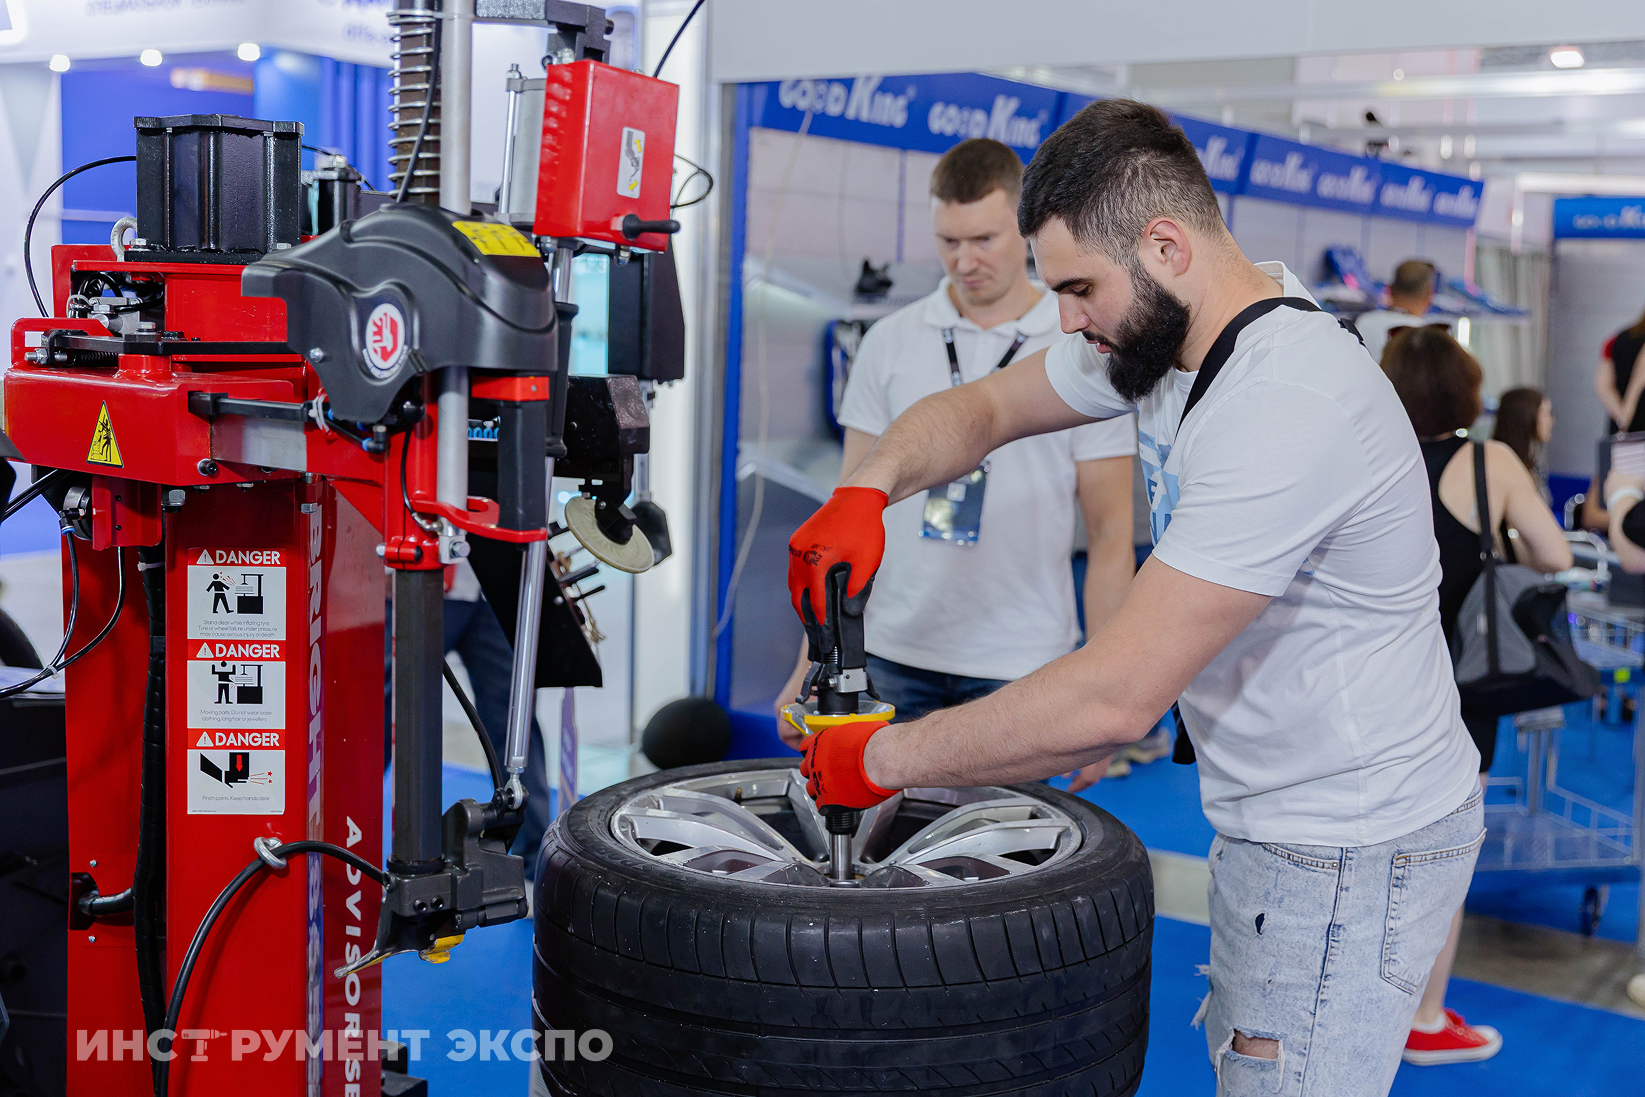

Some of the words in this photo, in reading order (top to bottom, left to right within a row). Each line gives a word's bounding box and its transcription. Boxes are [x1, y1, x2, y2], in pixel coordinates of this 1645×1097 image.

[215, 550, 281, 565] DANGER
[215, 643, 280, 658] DANGER
[309, 503, 323, 825] BRIGHT
[215, 732, 280, 747] DANGER
[345, 815, 362, 1041] ADVISOR
